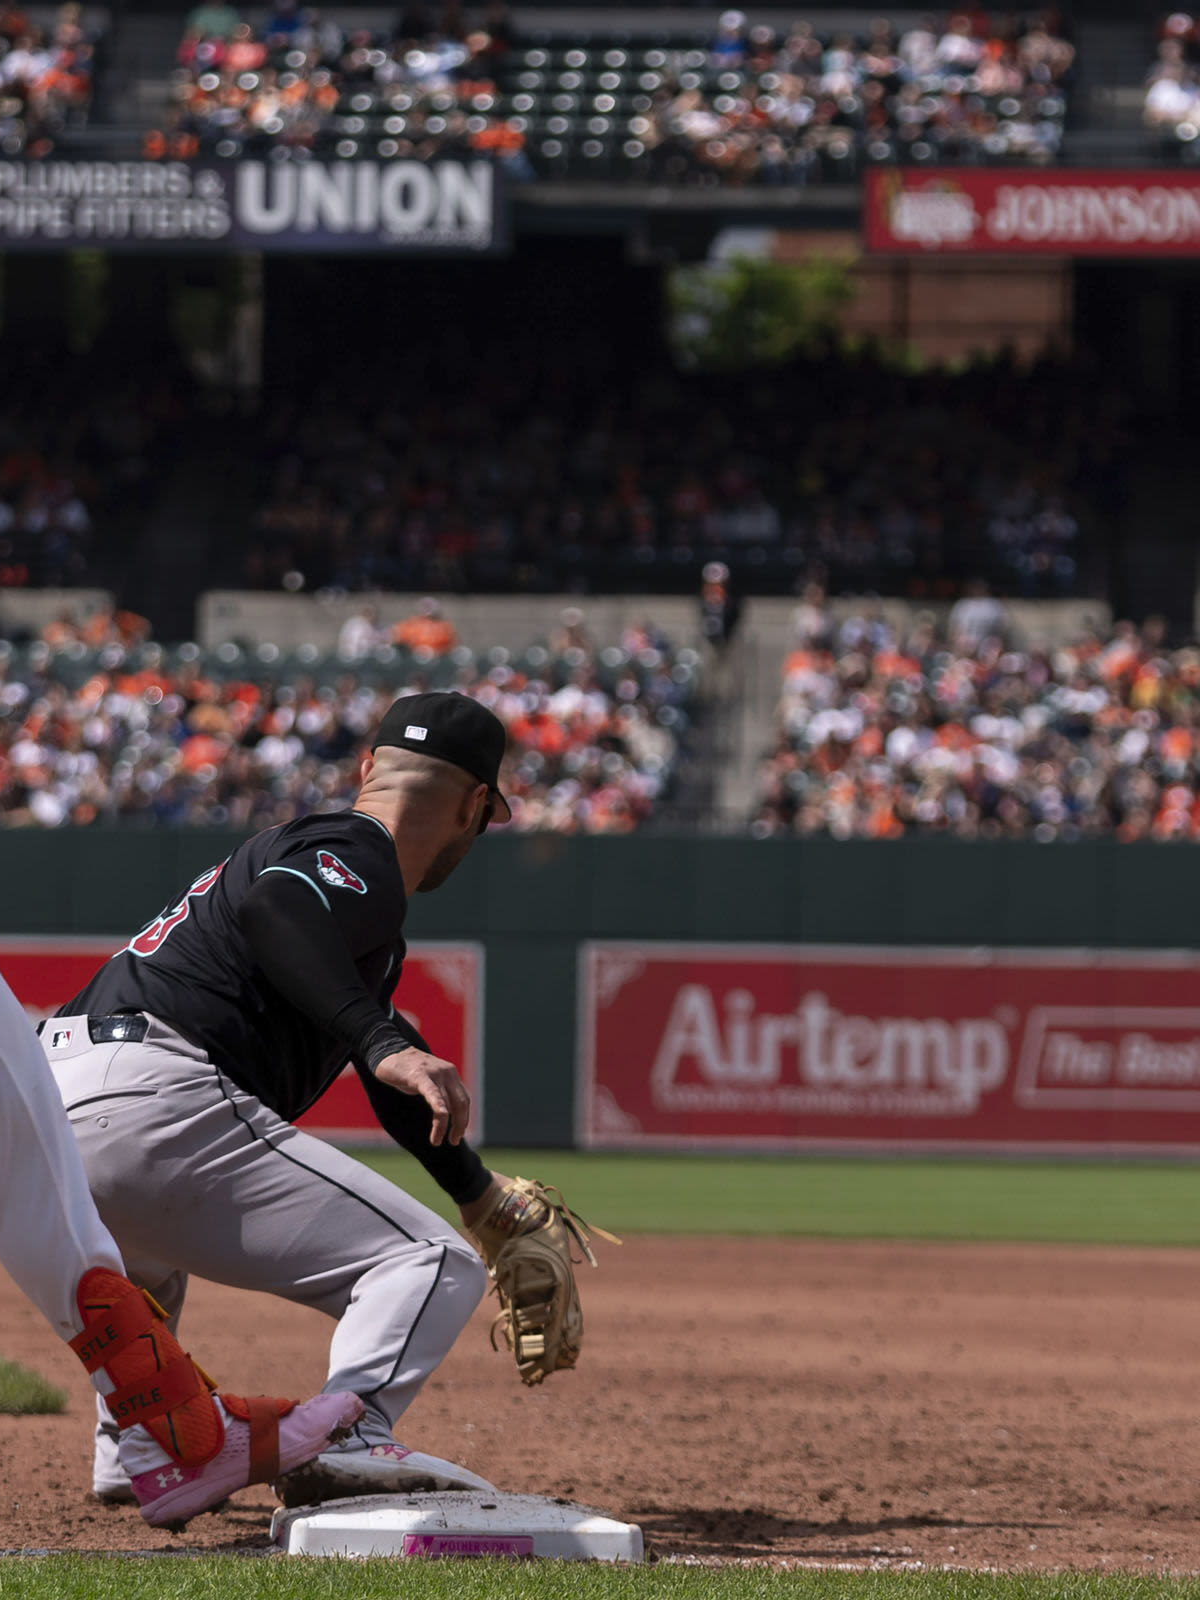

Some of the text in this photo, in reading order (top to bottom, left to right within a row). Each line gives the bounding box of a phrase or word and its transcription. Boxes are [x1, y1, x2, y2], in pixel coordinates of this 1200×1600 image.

[237, 160, 492, 234] UNION
[652, 985, 1008, 1100] Airtemp
[78, 1324, 119, 1361] STLE
